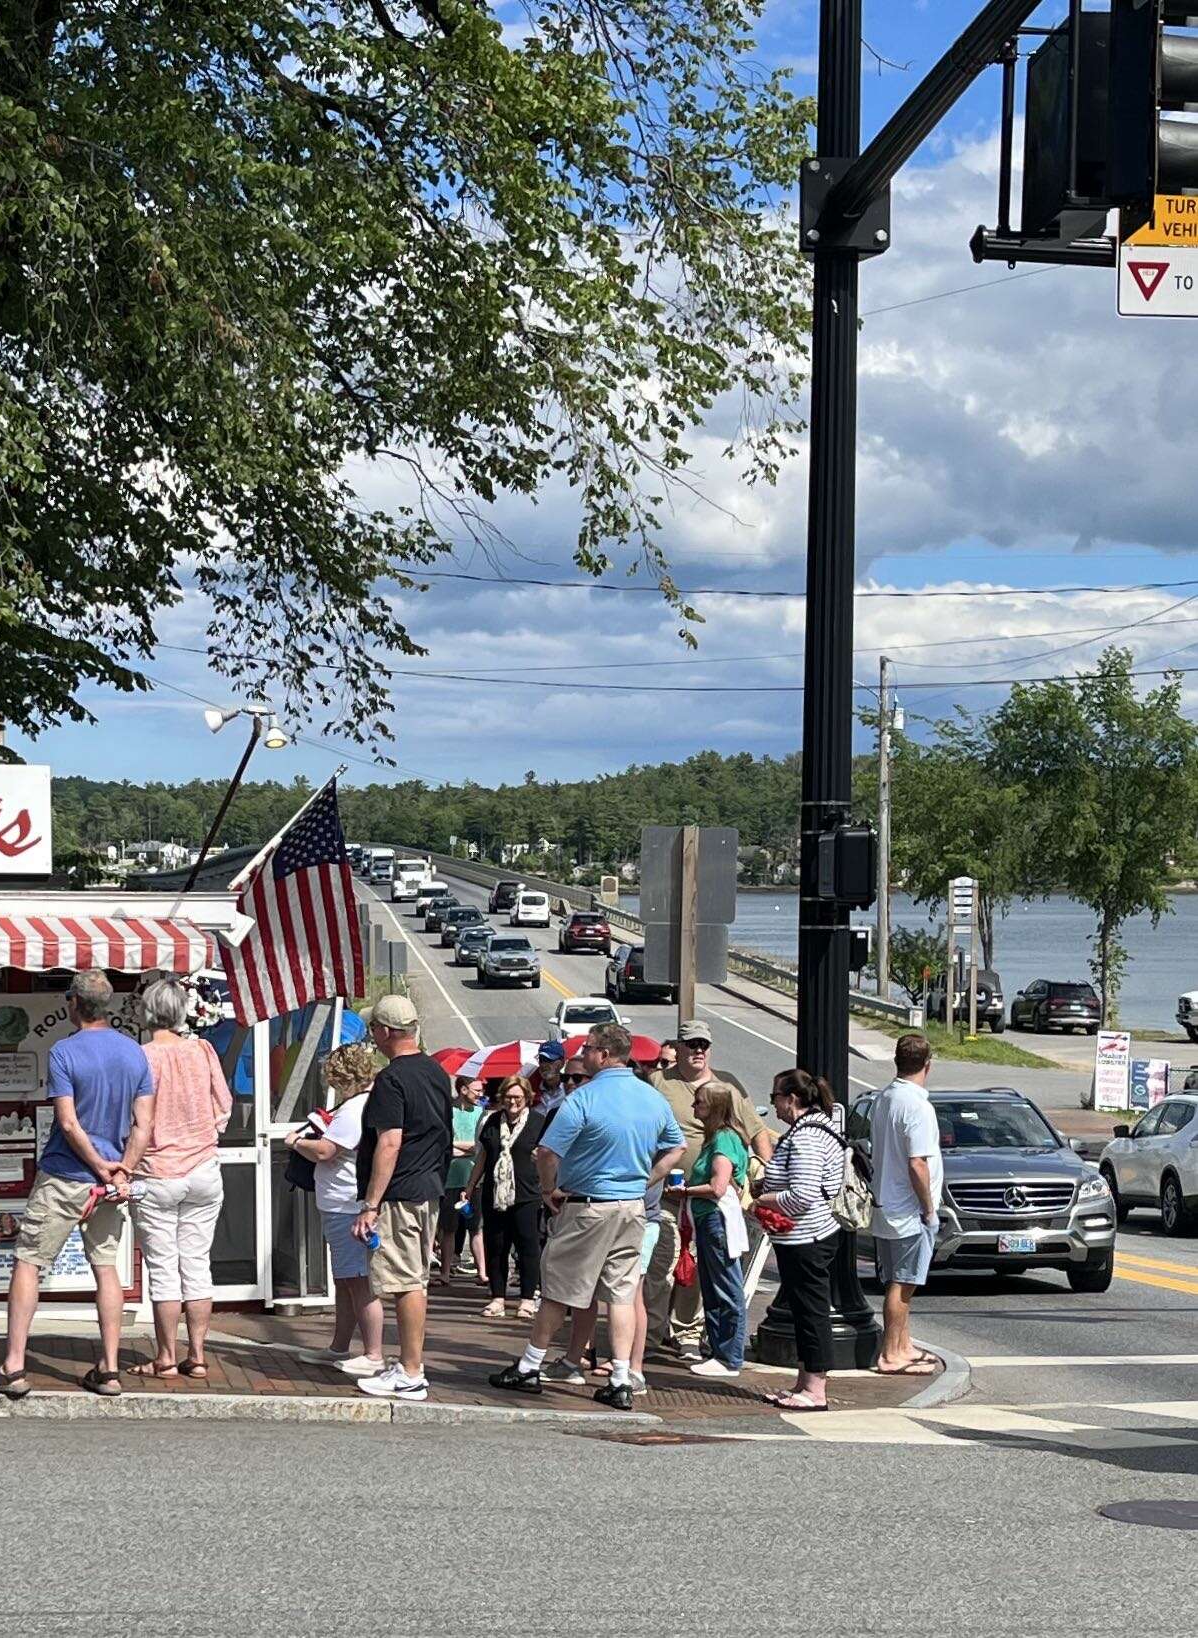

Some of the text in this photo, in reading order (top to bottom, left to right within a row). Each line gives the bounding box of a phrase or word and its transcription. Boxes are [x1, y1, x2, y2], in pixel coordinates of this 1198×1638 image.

[1166, 198, 1197, 214] TUR
[1163, 222, 1198, 237] VEHI
[1174, 275, 1194, 290] TO
[33, 1007, 69, 1038] ROU
